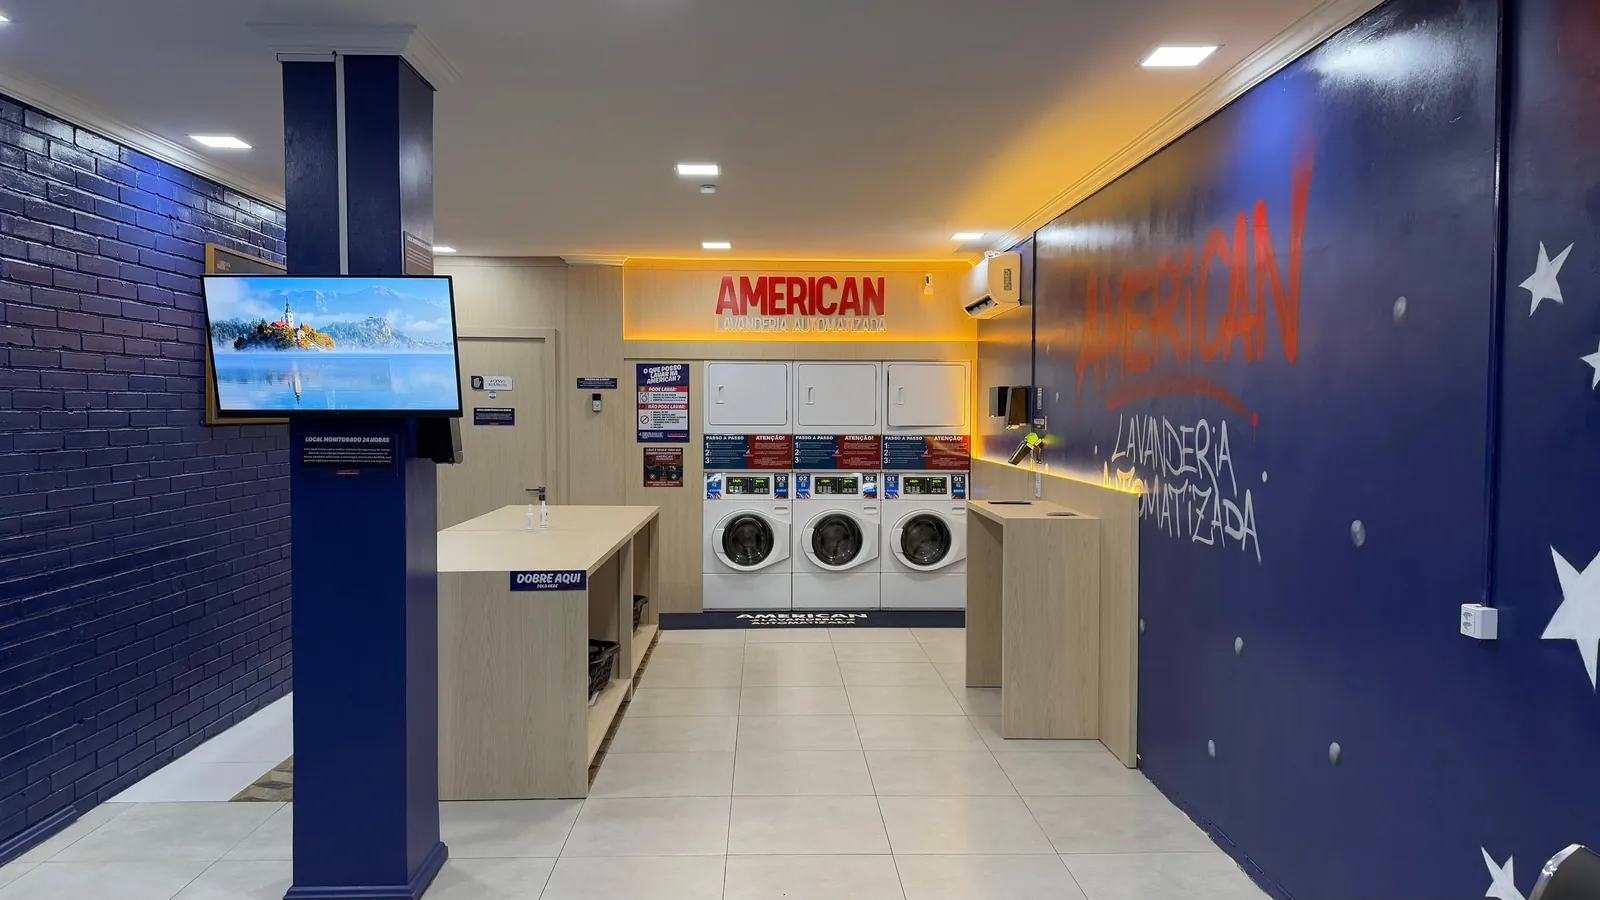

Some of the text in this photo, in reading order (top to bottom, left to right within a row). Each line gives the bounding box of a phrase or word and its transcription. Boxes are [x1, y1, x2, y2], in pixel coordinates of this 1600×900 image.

[716, 276, 885, 316] AMERICAN
[715, 317, 887, 332] LAVANDERIA AUTOMATIZADA
[661, 364, 682, 372] POSSO
[650, 371, 669, 379] LAVAR
[516, 573, 581, 584] DOBRE AQUI
